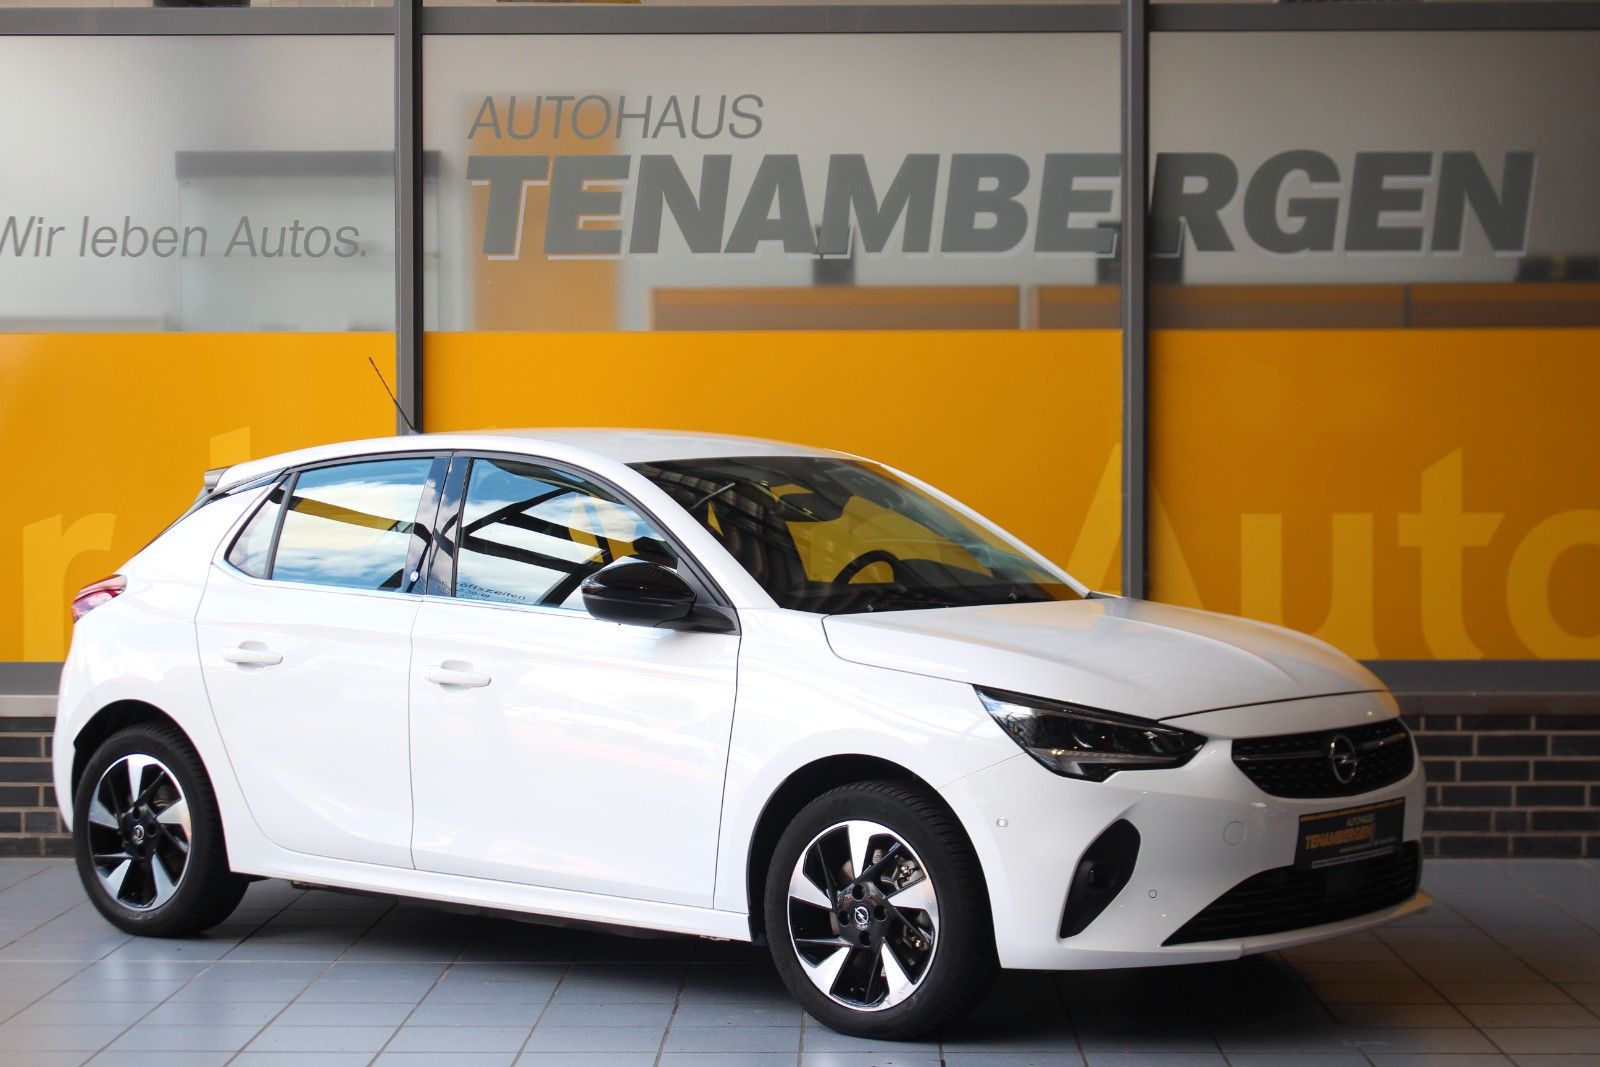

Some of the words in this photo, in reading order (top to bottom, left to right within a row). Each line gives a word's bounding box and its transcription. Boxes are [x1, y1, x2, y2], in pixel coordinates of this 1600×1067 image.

[467, 94, 764, 140] AUTOHAUS
[466, 149, 1537, 258] TENAMBERGEN
[0, 215, 65, 257] Wir
[79, 215, 208, 257] leben
[224, 215, 368, 257] Autos.
